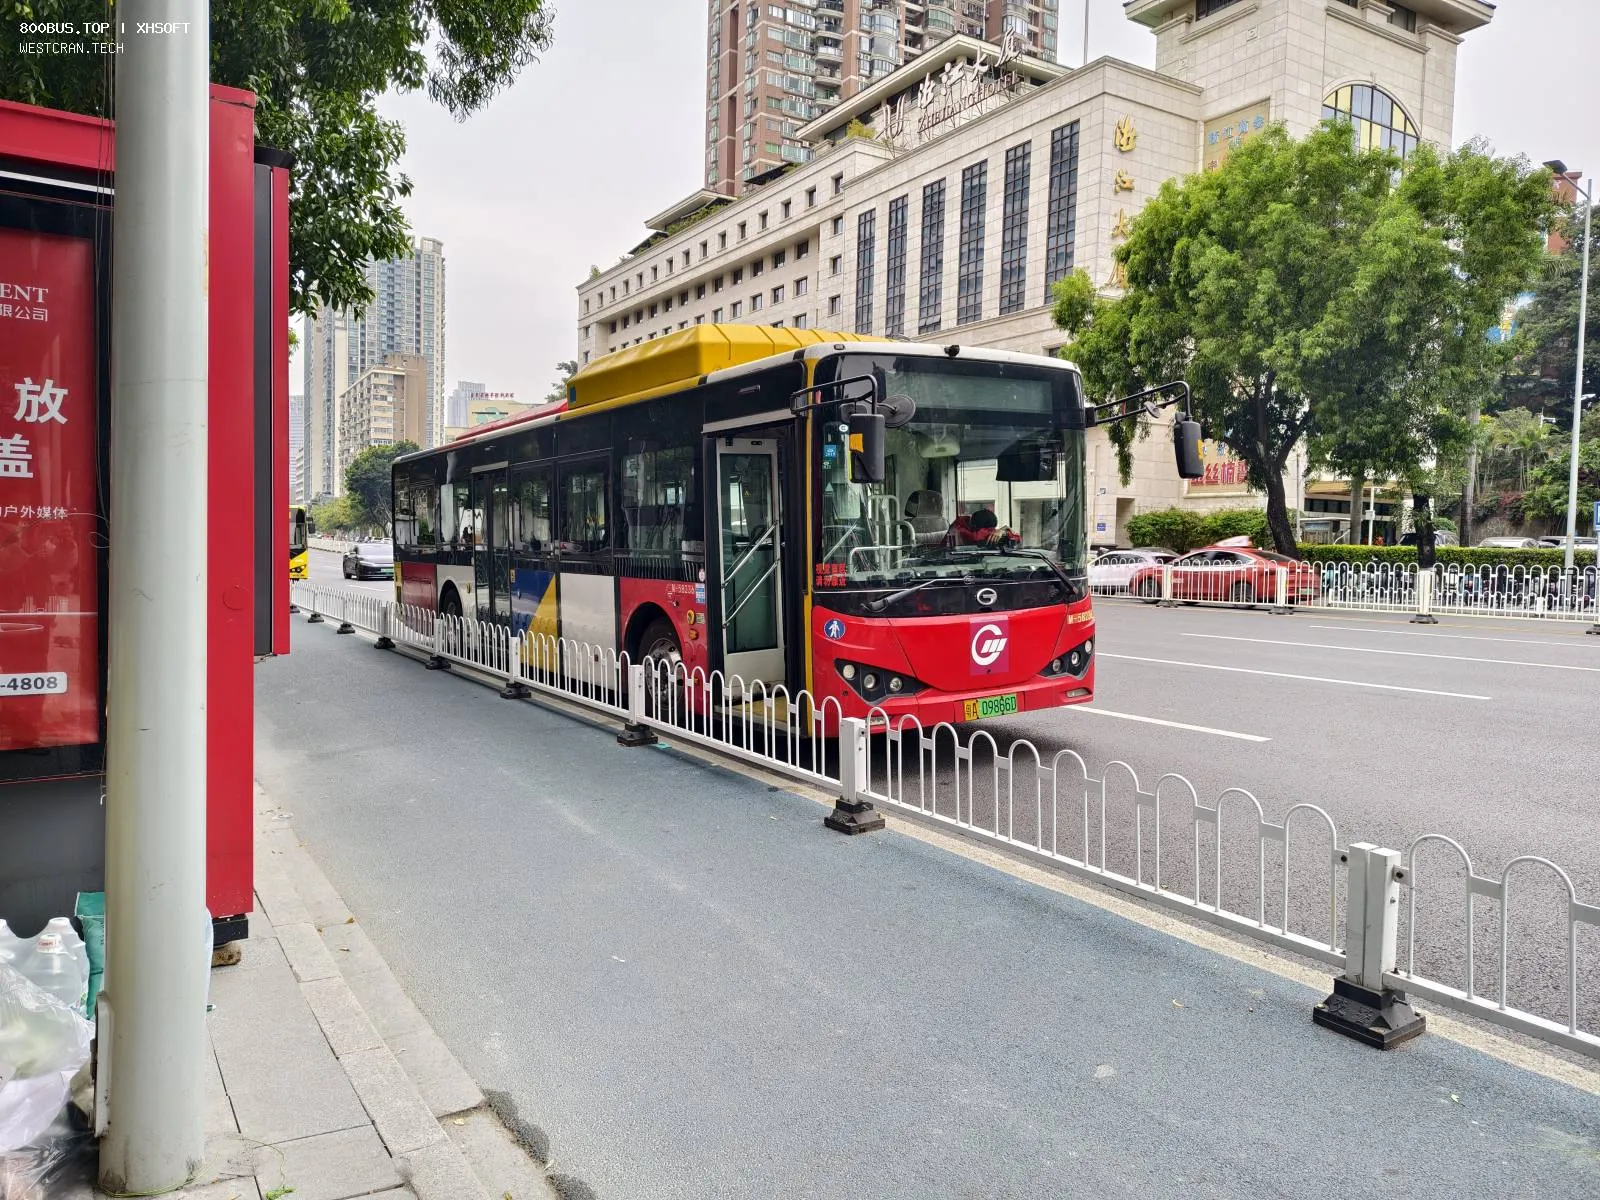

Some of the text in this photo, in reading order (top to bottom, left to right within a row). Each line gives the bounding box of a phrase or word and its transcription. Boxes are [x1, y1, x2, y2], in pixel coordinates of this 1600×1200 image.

[14, 377, 68, 424] 放
[0, 434, 33, 478] 盖
[0, 505, 67, 520] 户外媒体
